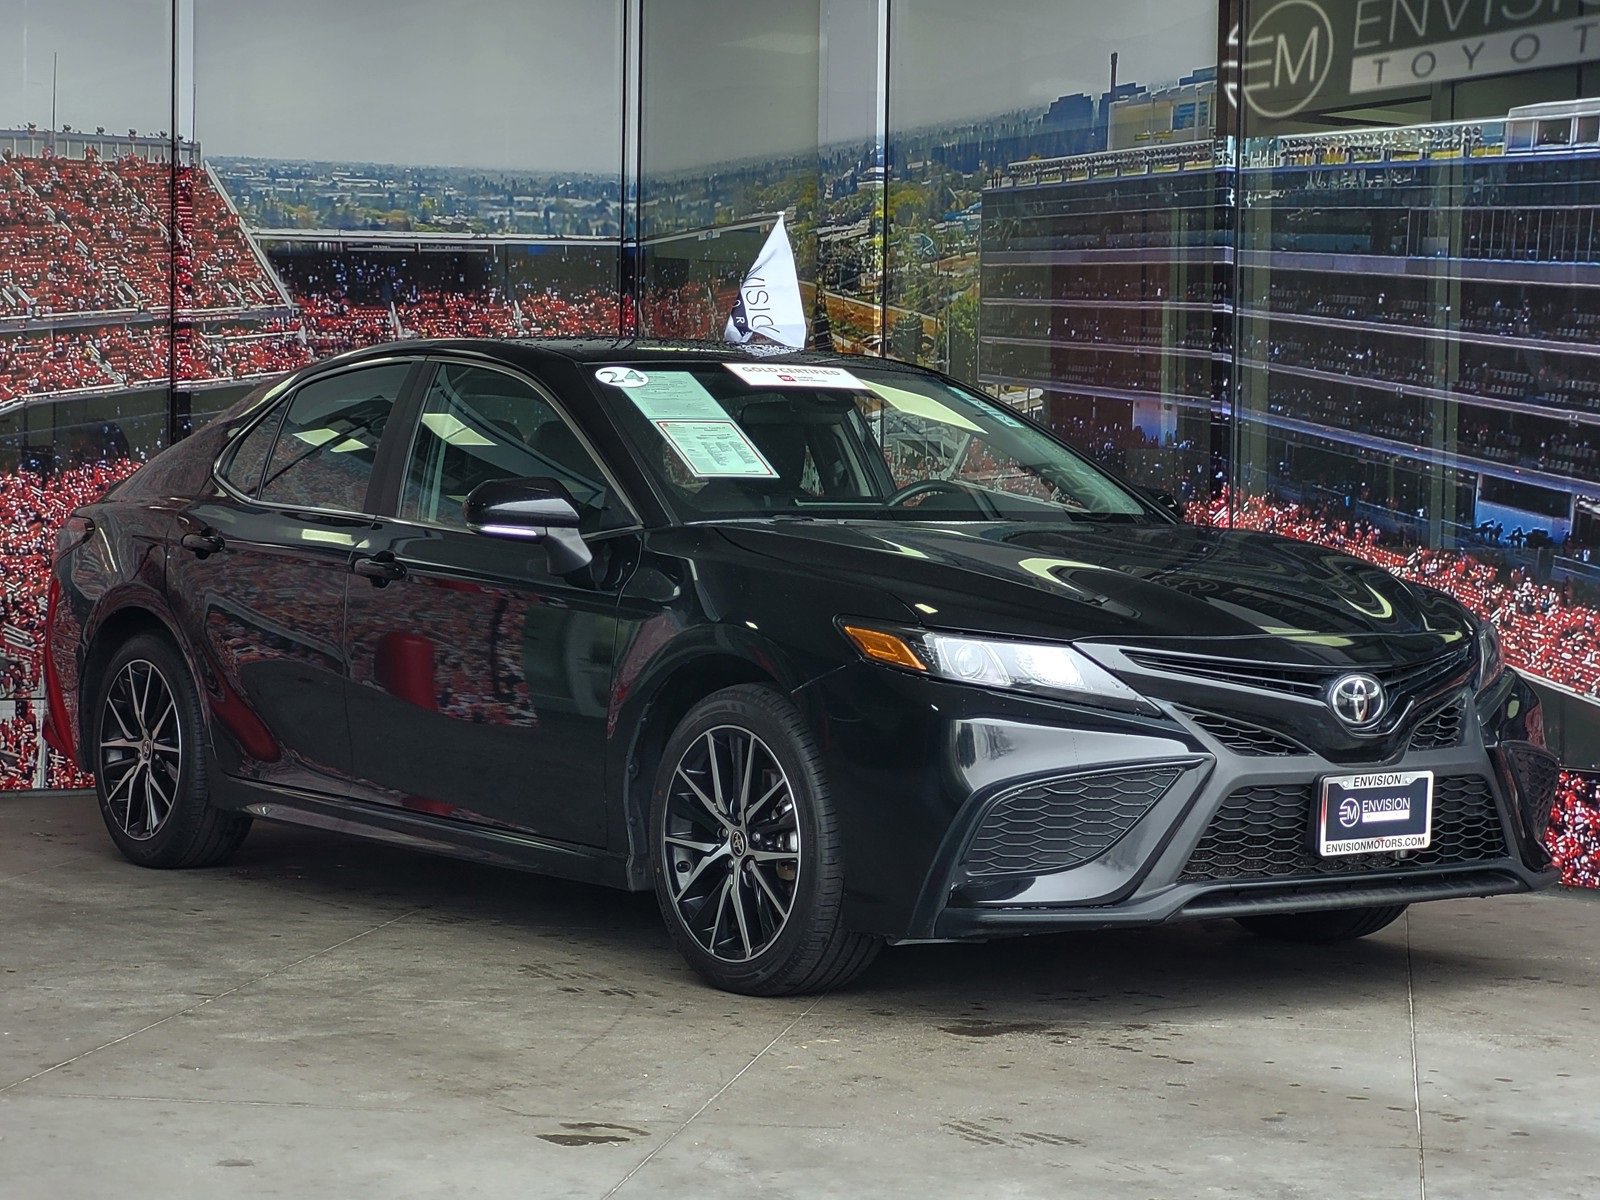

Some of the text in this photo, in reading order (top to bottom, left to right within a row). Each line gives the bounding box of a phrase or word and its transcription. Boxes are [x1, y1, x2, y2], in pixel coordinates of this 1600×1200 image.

[600, 370, 645, 384] 24
[780, 367, 841, 376] CERTIFIED
[1353, 774, 1402, 788] ENVISION
[1362, 797, 1411, 813] ENVISION
[1325, 836, 1426, 854] ENVISIONMOTORS.COM
